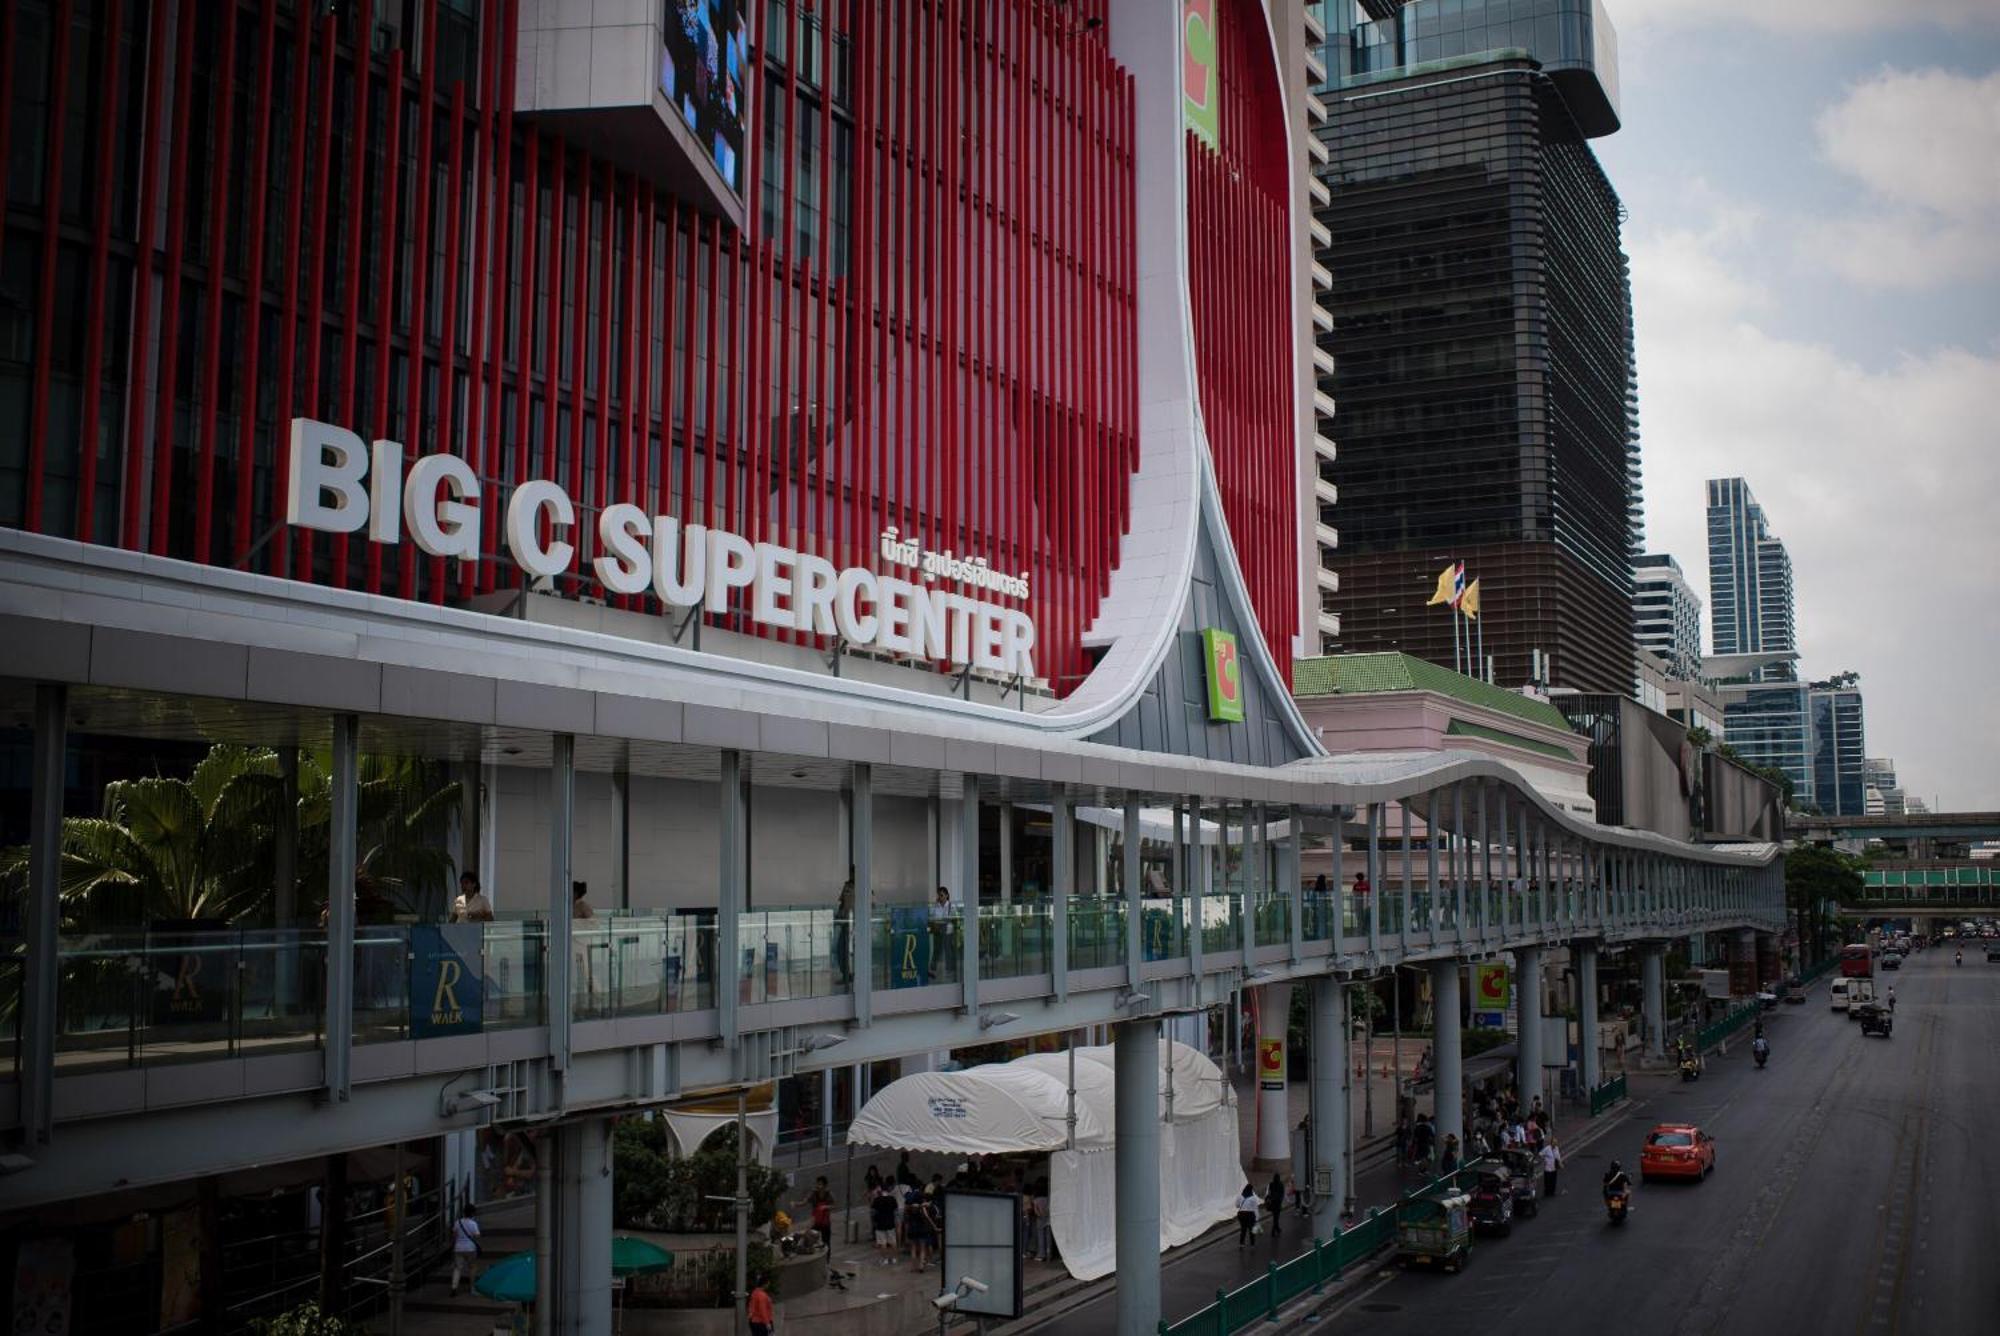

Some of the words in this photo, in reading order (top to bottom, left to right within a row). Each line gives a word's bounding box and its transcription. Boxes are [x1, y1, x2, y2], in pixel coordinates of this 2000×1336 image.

[286, 418, 481, 561] BIG
[507, 481, 574, 577] C
[594, 503, 1035, 678] SUPERCENTER
[903, 934, 917, 970] R
[173, 954, 202, 999] R
[432, 960, 462, 1011] R
[430, 1011, 465, 1025] WALK
